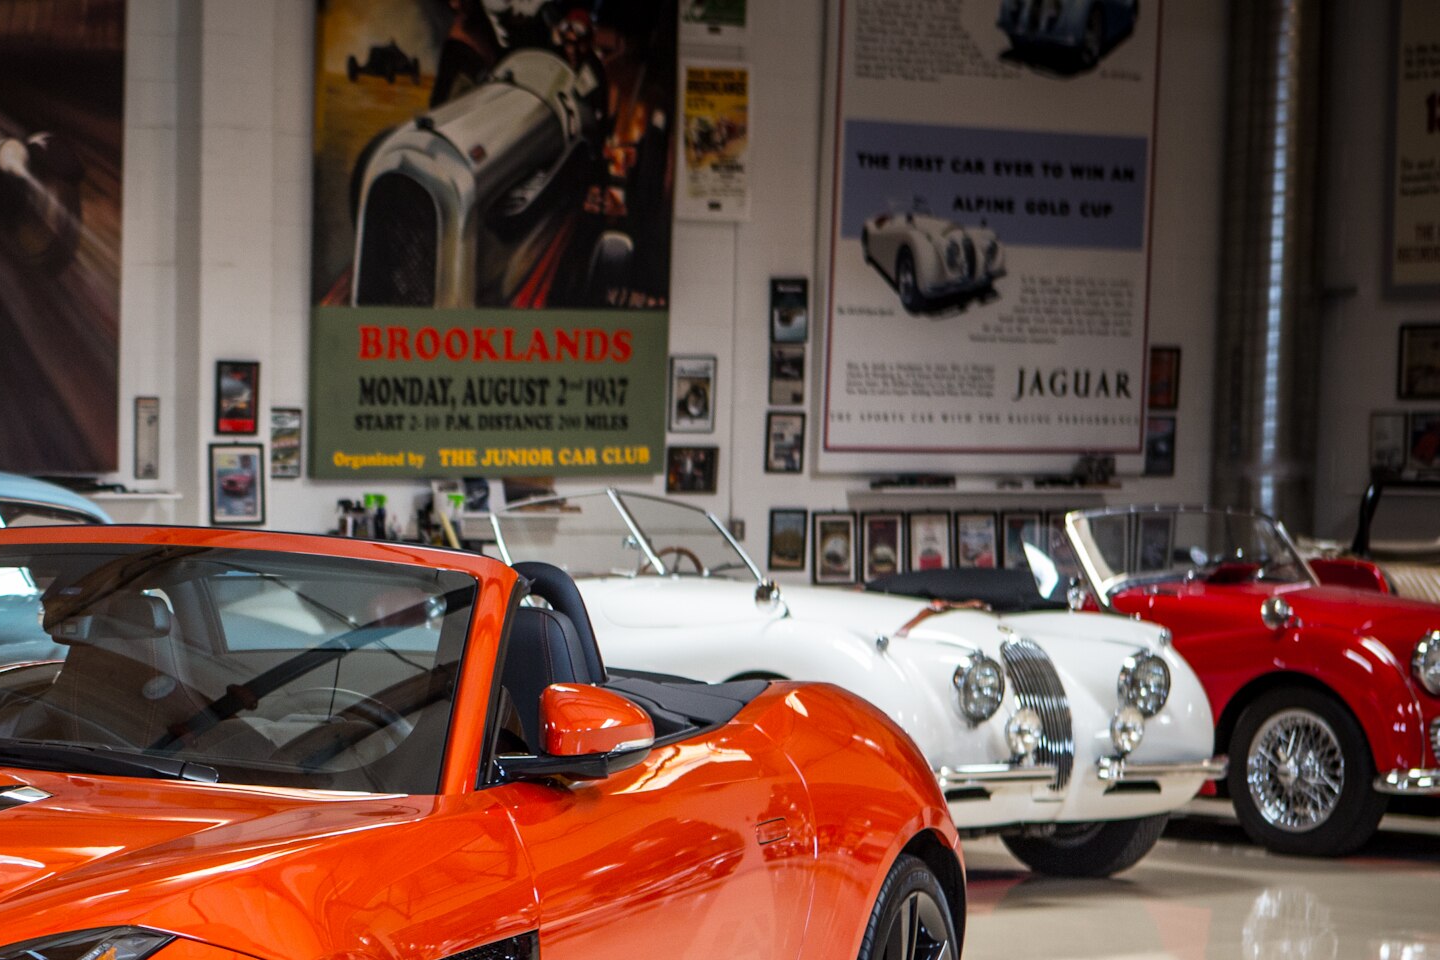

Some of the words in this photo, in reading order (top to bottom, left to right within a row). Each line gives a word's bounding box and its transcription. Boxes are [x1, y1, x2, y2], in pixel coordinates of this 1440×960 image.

[856, 151, 891, 170] THE
[898, 153, 945, 173] FIRST
[950, 156, 985, 175] CAR
[993, 159, 1034, 177] EVER
[1041, 162, 1063, 179] TO
[1070, 162, 1104, 181] WIN
[1110, 164, 1135, 182] AN
[952, 195, 1015, 215] ALPINE
[1024, 198, 1071, 217] GOLD
[1078, 200, 1114, 219] CUP
[358, 325, 633, 363] BROOKLANDS
[358, 376, 457, 409] MONDAY,
[463, 377, 550, 406] AUGUST
[585, 377, 629, 406] 1937
[1013, 367, 1133, 401] JAGUAR
[355, 415, 404, 431] START
[478, 415, 553, 431] DISTANCE
[584, 415, 629, 431] MILES
[408, 452, 426, 469] by
[439, 449, 477, 467] THE
[481, 448, 554, 467] JUNIOR
[558, 447, 598, 466] CAR
[602, 446, 650, 465] CLUB
